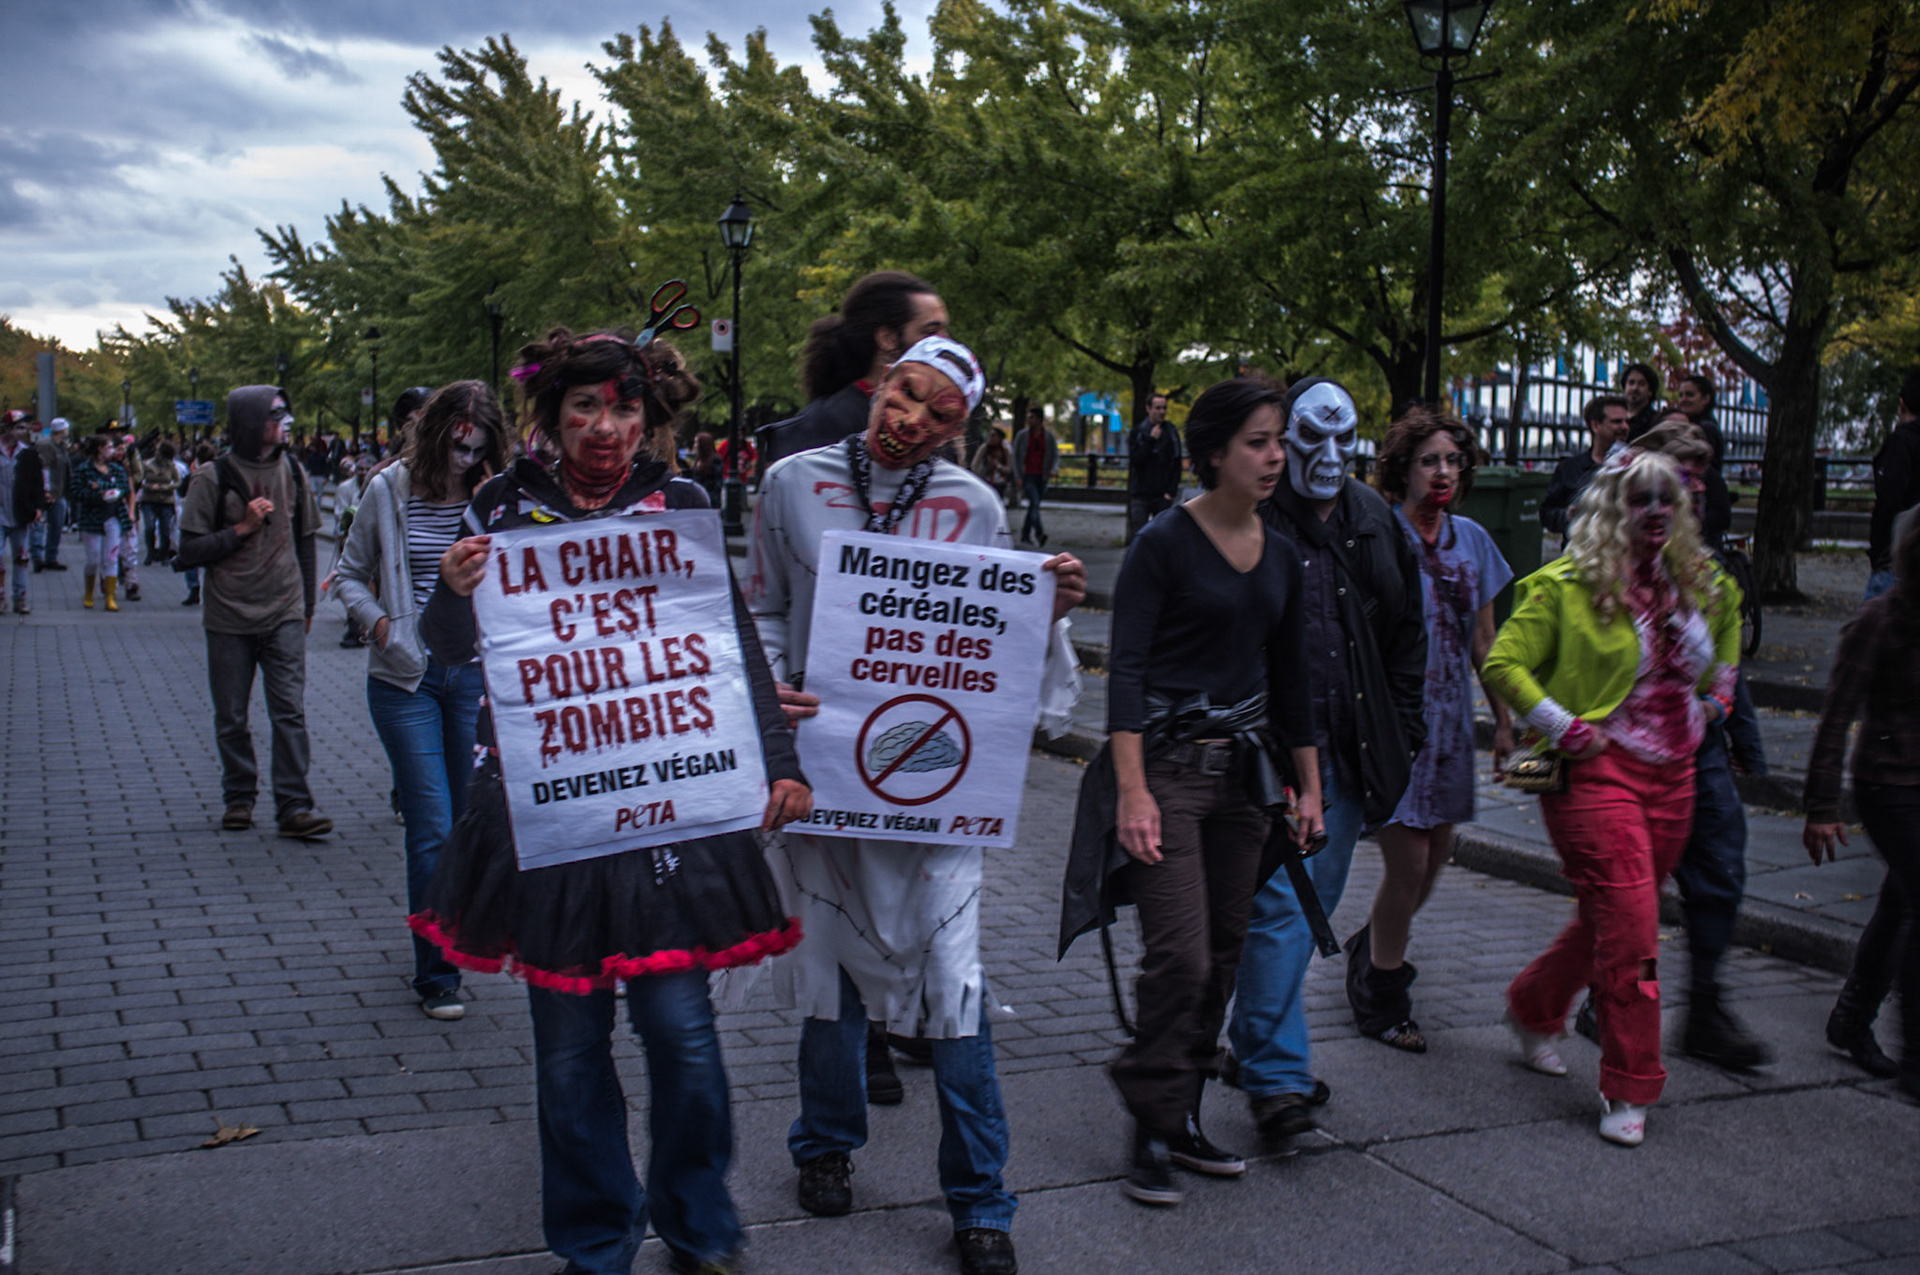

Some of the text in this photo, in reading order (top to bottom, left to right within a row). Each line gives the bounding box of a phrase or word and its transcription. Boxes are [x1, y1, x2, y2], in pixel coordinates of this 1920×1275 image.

[496, 528, 696, 597] LA CHAIR,
[838, 544, 1036, 595] Mangez des
[549, 583, 660, 643] C'EST
[859, 588, 1007, 635] céréales,
[517, 632, 713, 707] POUR LES
[863, 625, 992, 661] pas des
[850, 656, 998, 693] cervelles
[534, 685, 717, 769] ZOMBIES
[532, 748, 738, 805] DEVENEZ VÉGAN
[883, 811, 942, 833] VÉGAN
